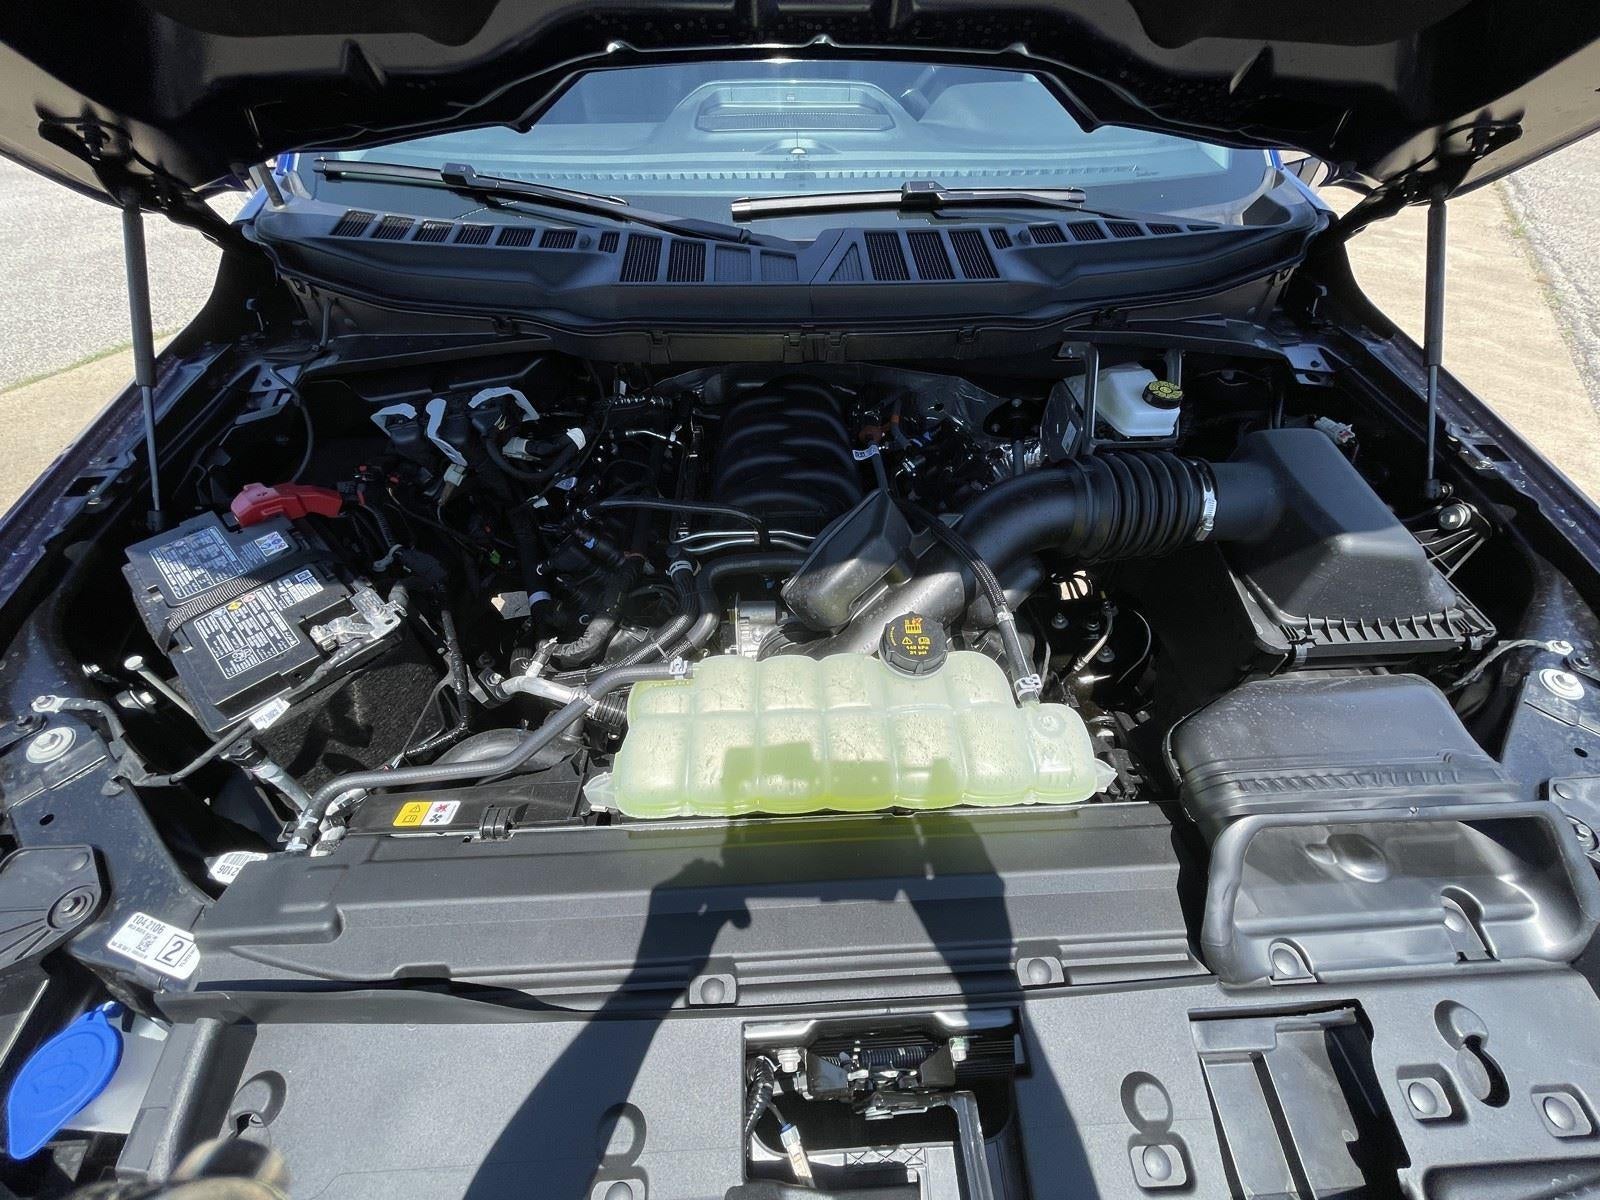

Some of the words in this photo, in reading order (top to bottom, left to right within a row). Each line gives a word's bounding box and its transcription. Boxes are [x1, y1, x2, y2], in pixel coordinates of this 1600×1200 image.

[133, 915, 148, 926] 104
[146, 919, 167, 934] 2106
[162, 940, 185, 962] 2
